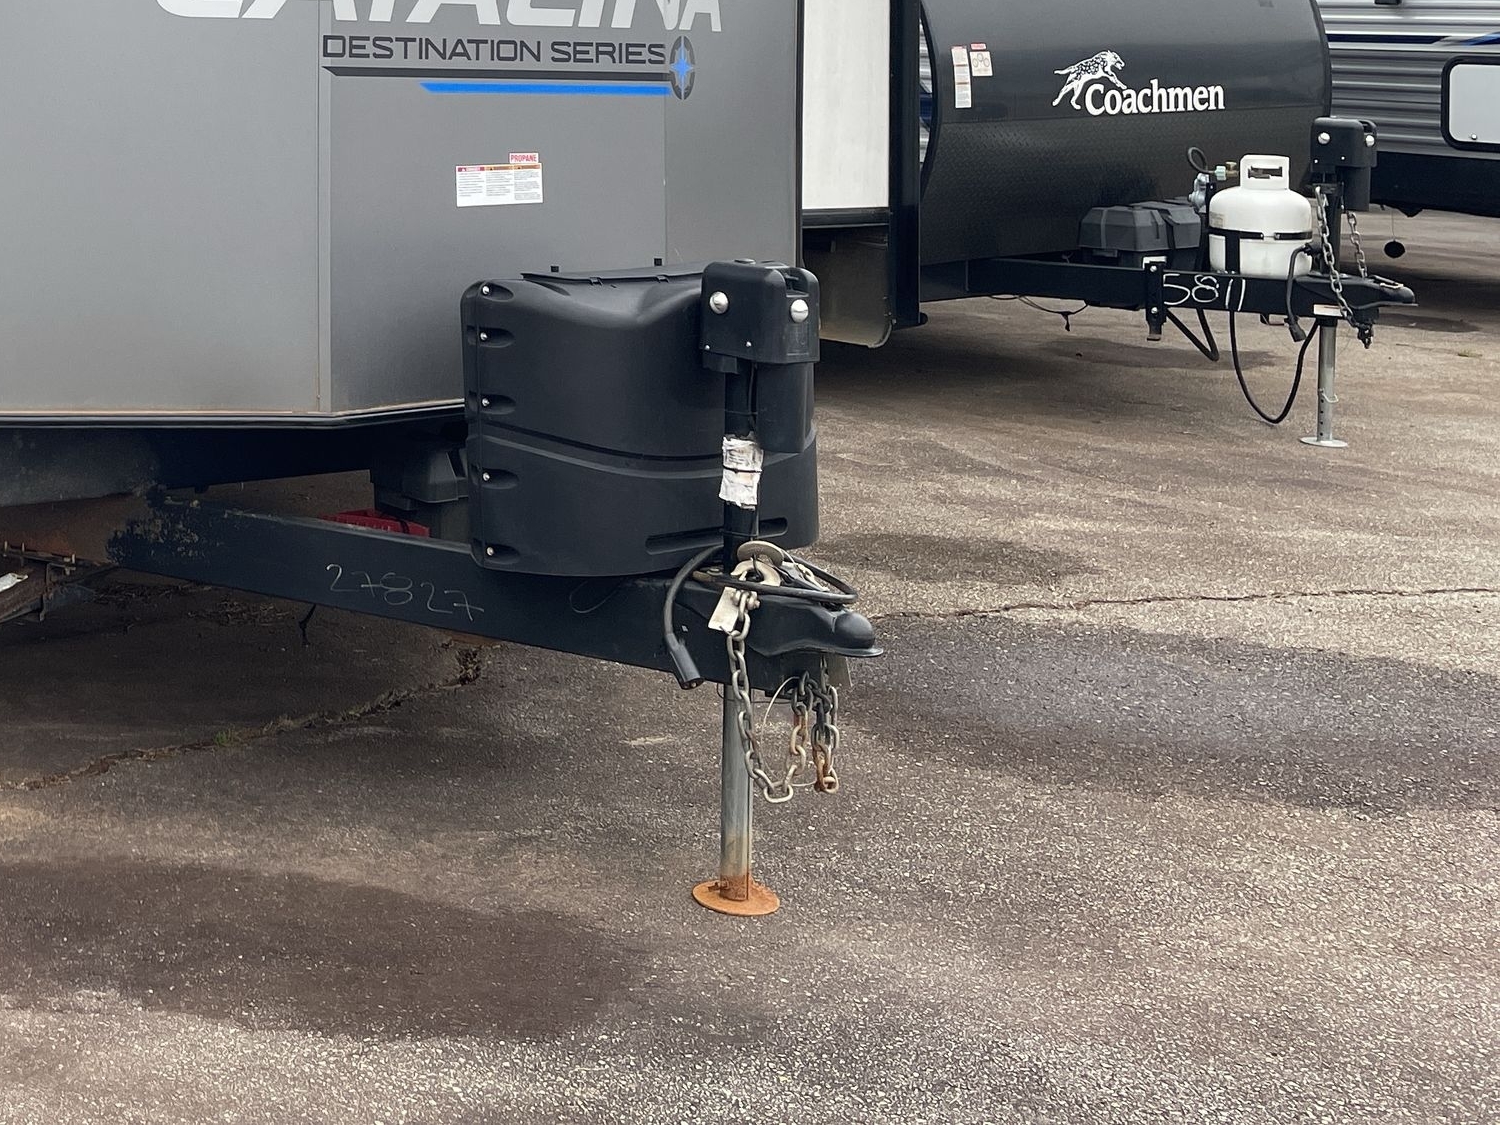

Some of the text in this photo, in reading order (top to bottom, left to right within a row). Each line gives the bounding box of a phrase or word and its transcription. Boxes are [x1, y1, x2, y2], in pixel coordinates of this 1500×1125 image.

[323, 35, 666, 65] DESTINATION SERIES
[1084, 79, 1226, 116] Coachmen
[510, 154, 537, 162] PROPANE
